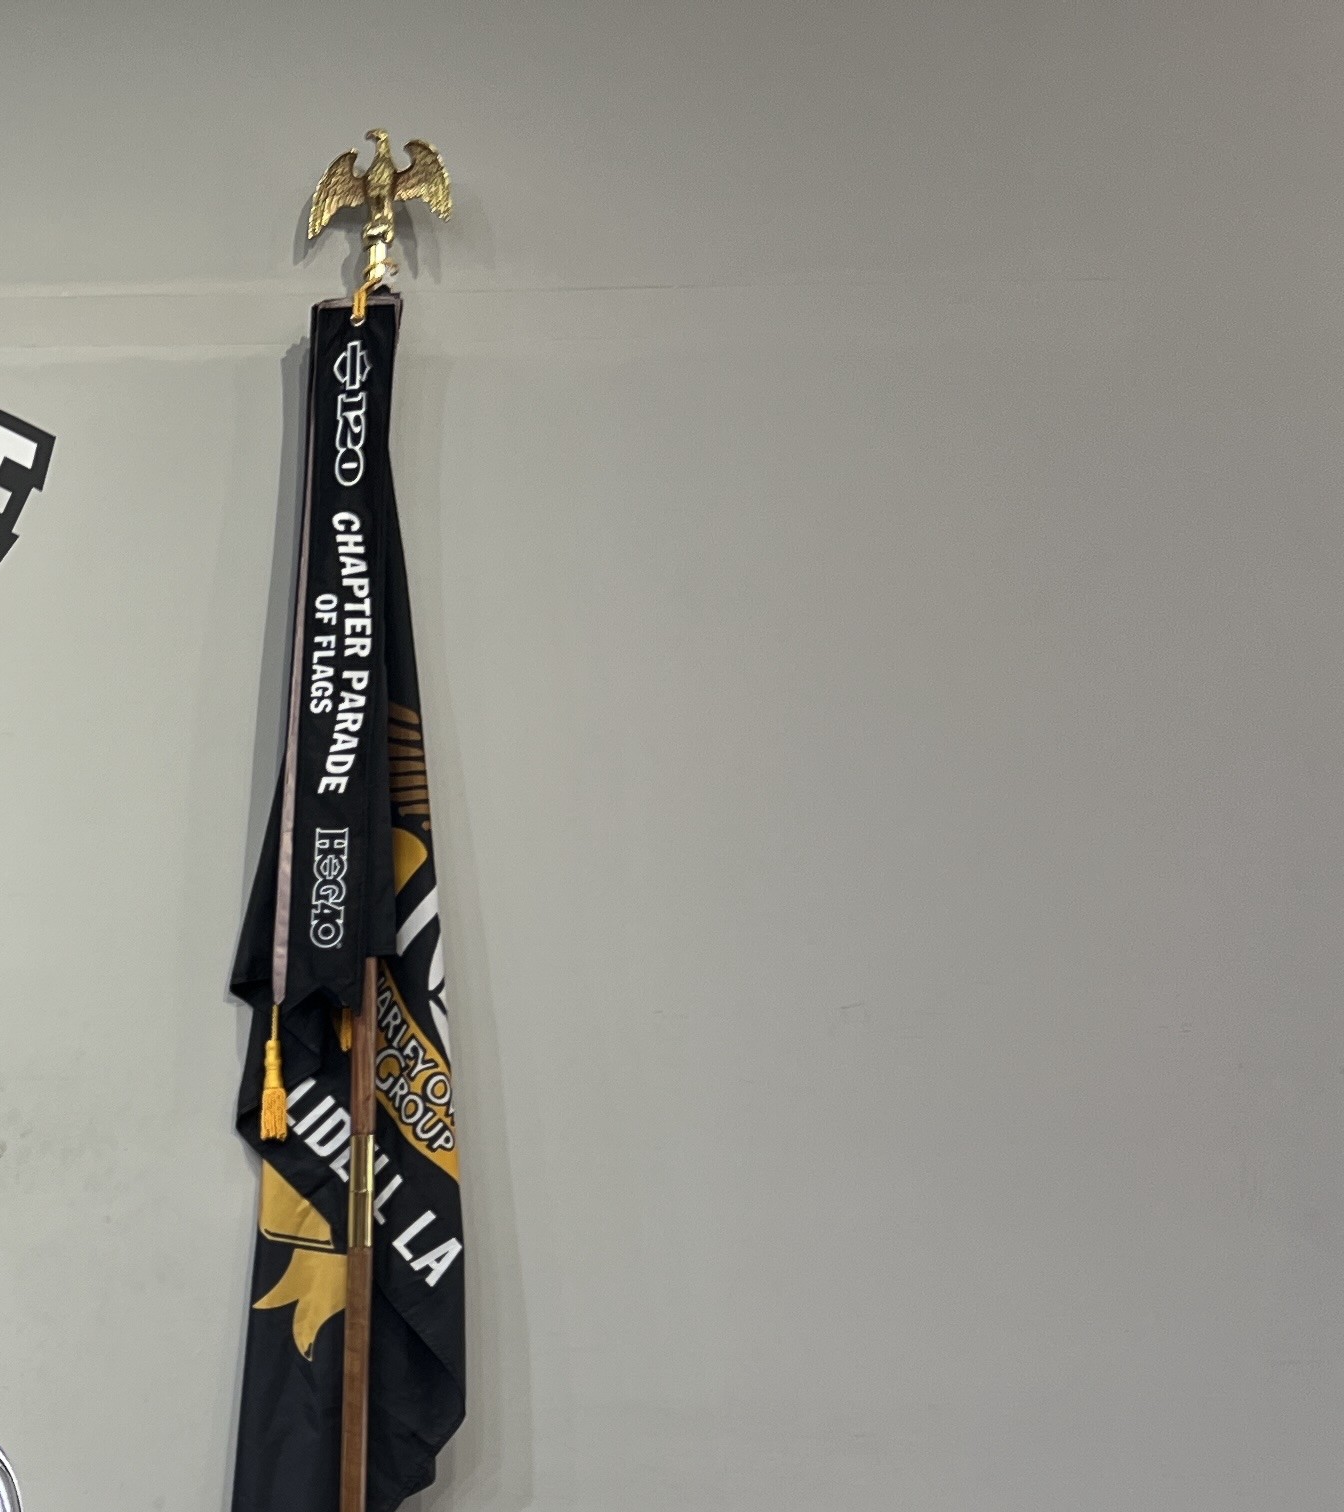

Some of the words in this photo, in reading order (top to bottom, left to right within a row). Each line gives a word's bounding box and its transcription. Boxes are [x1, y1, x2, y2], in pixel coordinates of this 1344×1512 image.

[334, 391, 367, 487] 120
[314, 592, 339, 626] OF
[331, 510, 373, 658] CHAPTER
[309, 634, 337, 715] FLAGS
[317, 669, 370, 795] PARADE
[375, 1048, 454, 1150] GROUP
[391, 1209, 463, 1288] LA
